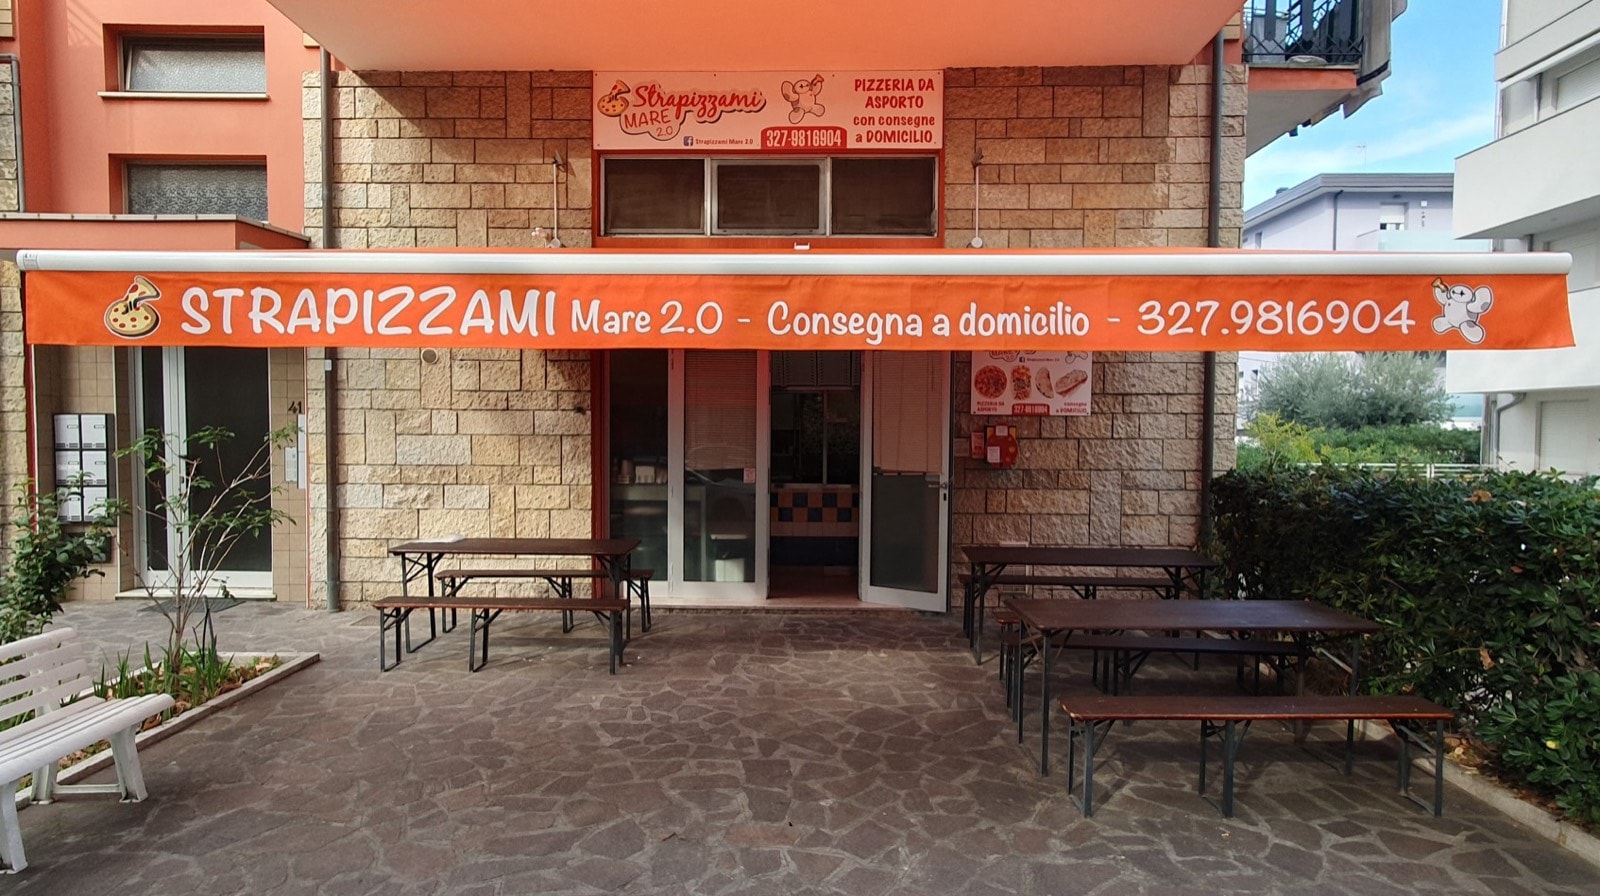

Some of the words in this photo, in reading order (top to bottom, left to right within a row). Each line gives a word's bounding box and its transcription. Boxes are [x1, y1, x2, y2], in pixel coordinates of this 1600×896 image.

[854, 79, 915, 92] PIZZERIA
[918, 79, 935, 91] DA
[633, 83, 762, 120] Strapizzami
[865, 95, 924, 108] ASPORTO
[624, 109, 671, 129] MARE
[853, 116, 875, 126] con
[878, 115, 935, 128] consegne
[656, 125, 673, 137] 2.0
[855, 133, 863, 143] a
[866, 130, 933, 143] DOMICILIO
[695, 138, 728, 146] Strapizzami
[766, 129, 842, 147] 327-9816904
[181, 286, 555, 337] STRAPIZZAMI
[571, 298, 651, 334] Mare
[660, 300, 723, 335] 2.0
[767, 300, 923, 346] Consegna
[932, 313, 950, 337] a
[958, 301, 1090, 336] domicilio
[1136, 299, 1416, 336] 327.9816904
[288, 400, 302, 414] 41
